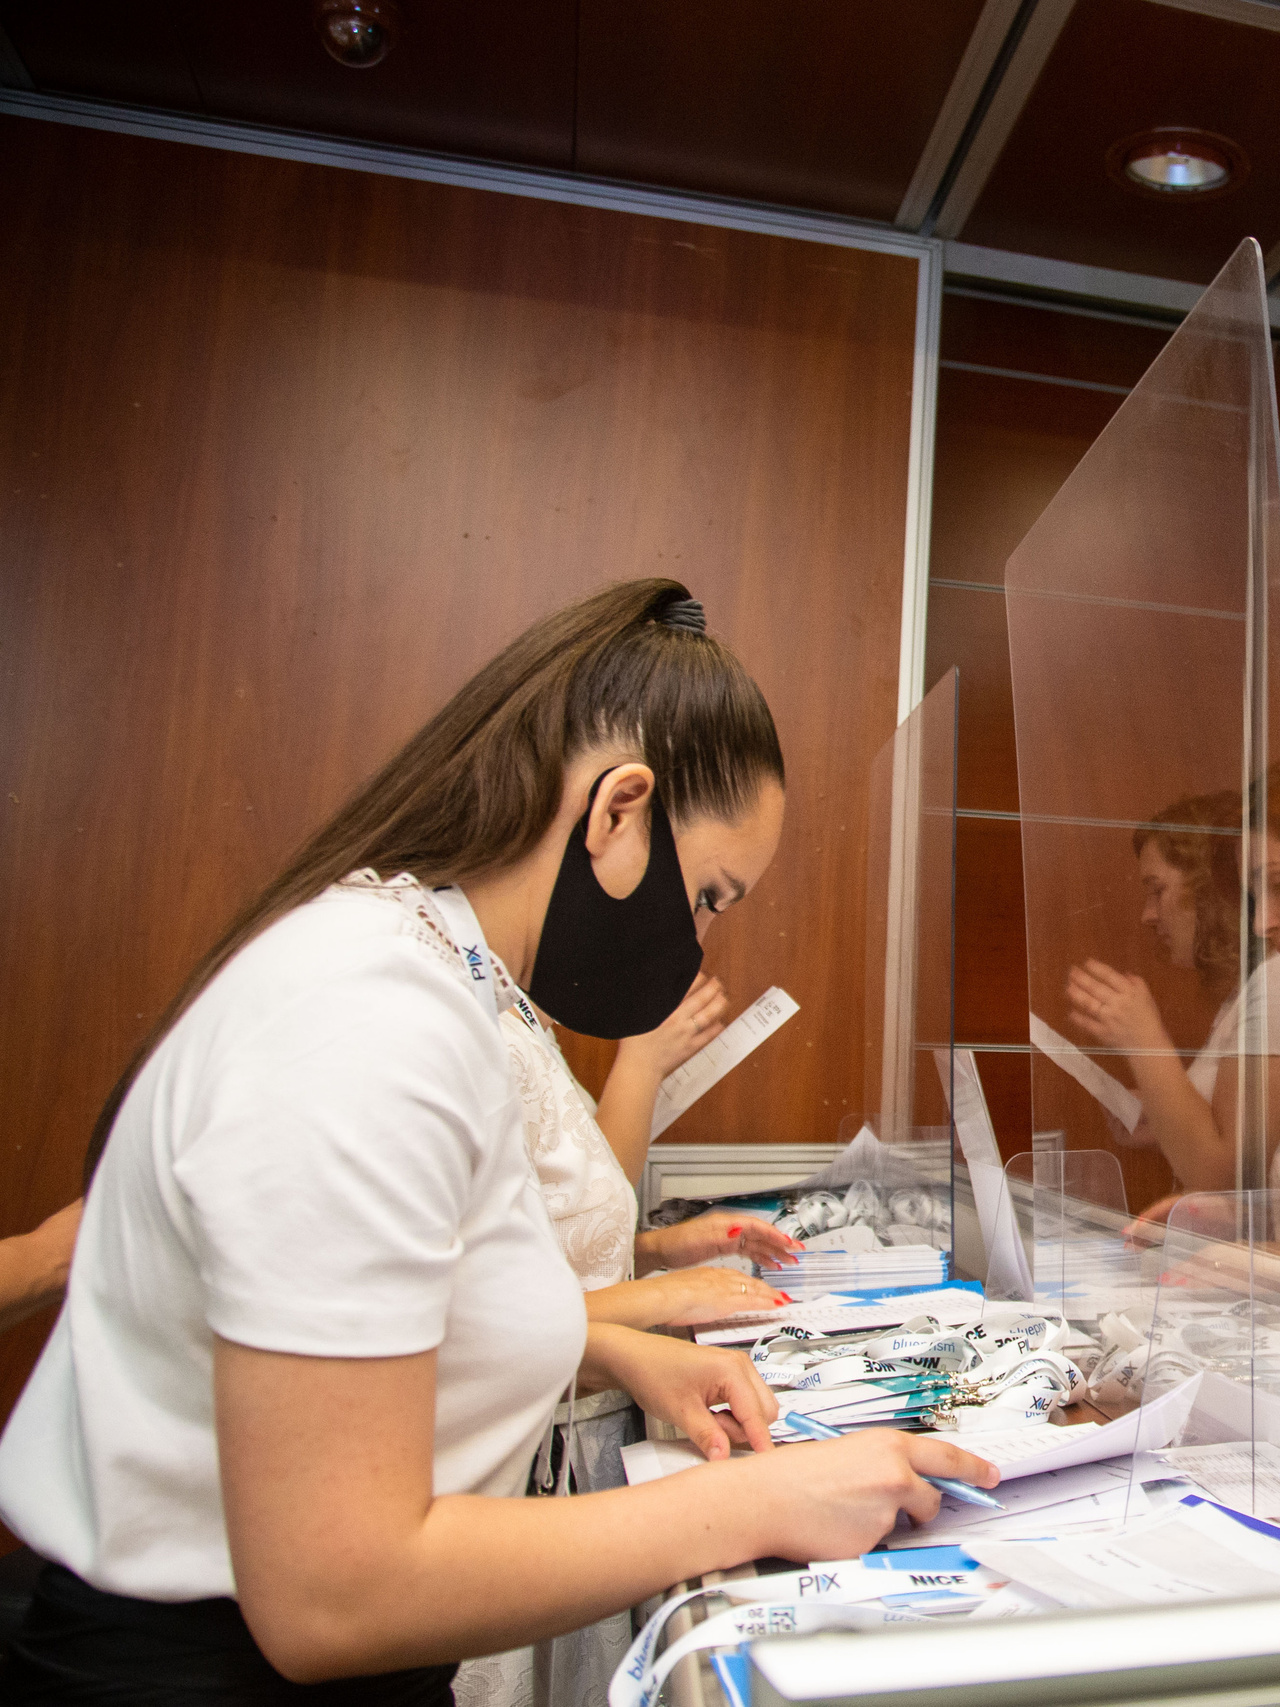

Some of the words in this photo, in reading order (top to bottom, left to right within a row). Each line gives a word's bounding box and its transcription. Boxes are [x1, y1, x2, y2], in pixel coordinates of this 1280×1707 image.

[461, 944, 486, 981] PIX
[515, 997, 539, 1027] NICE
[1029, 1395, 1053, 1411] PIX
[798, 1572, 842, 1597] PIX
[908, 1574, 969, 1587] NICE
[735, 1623, 766, 1635] RPA
